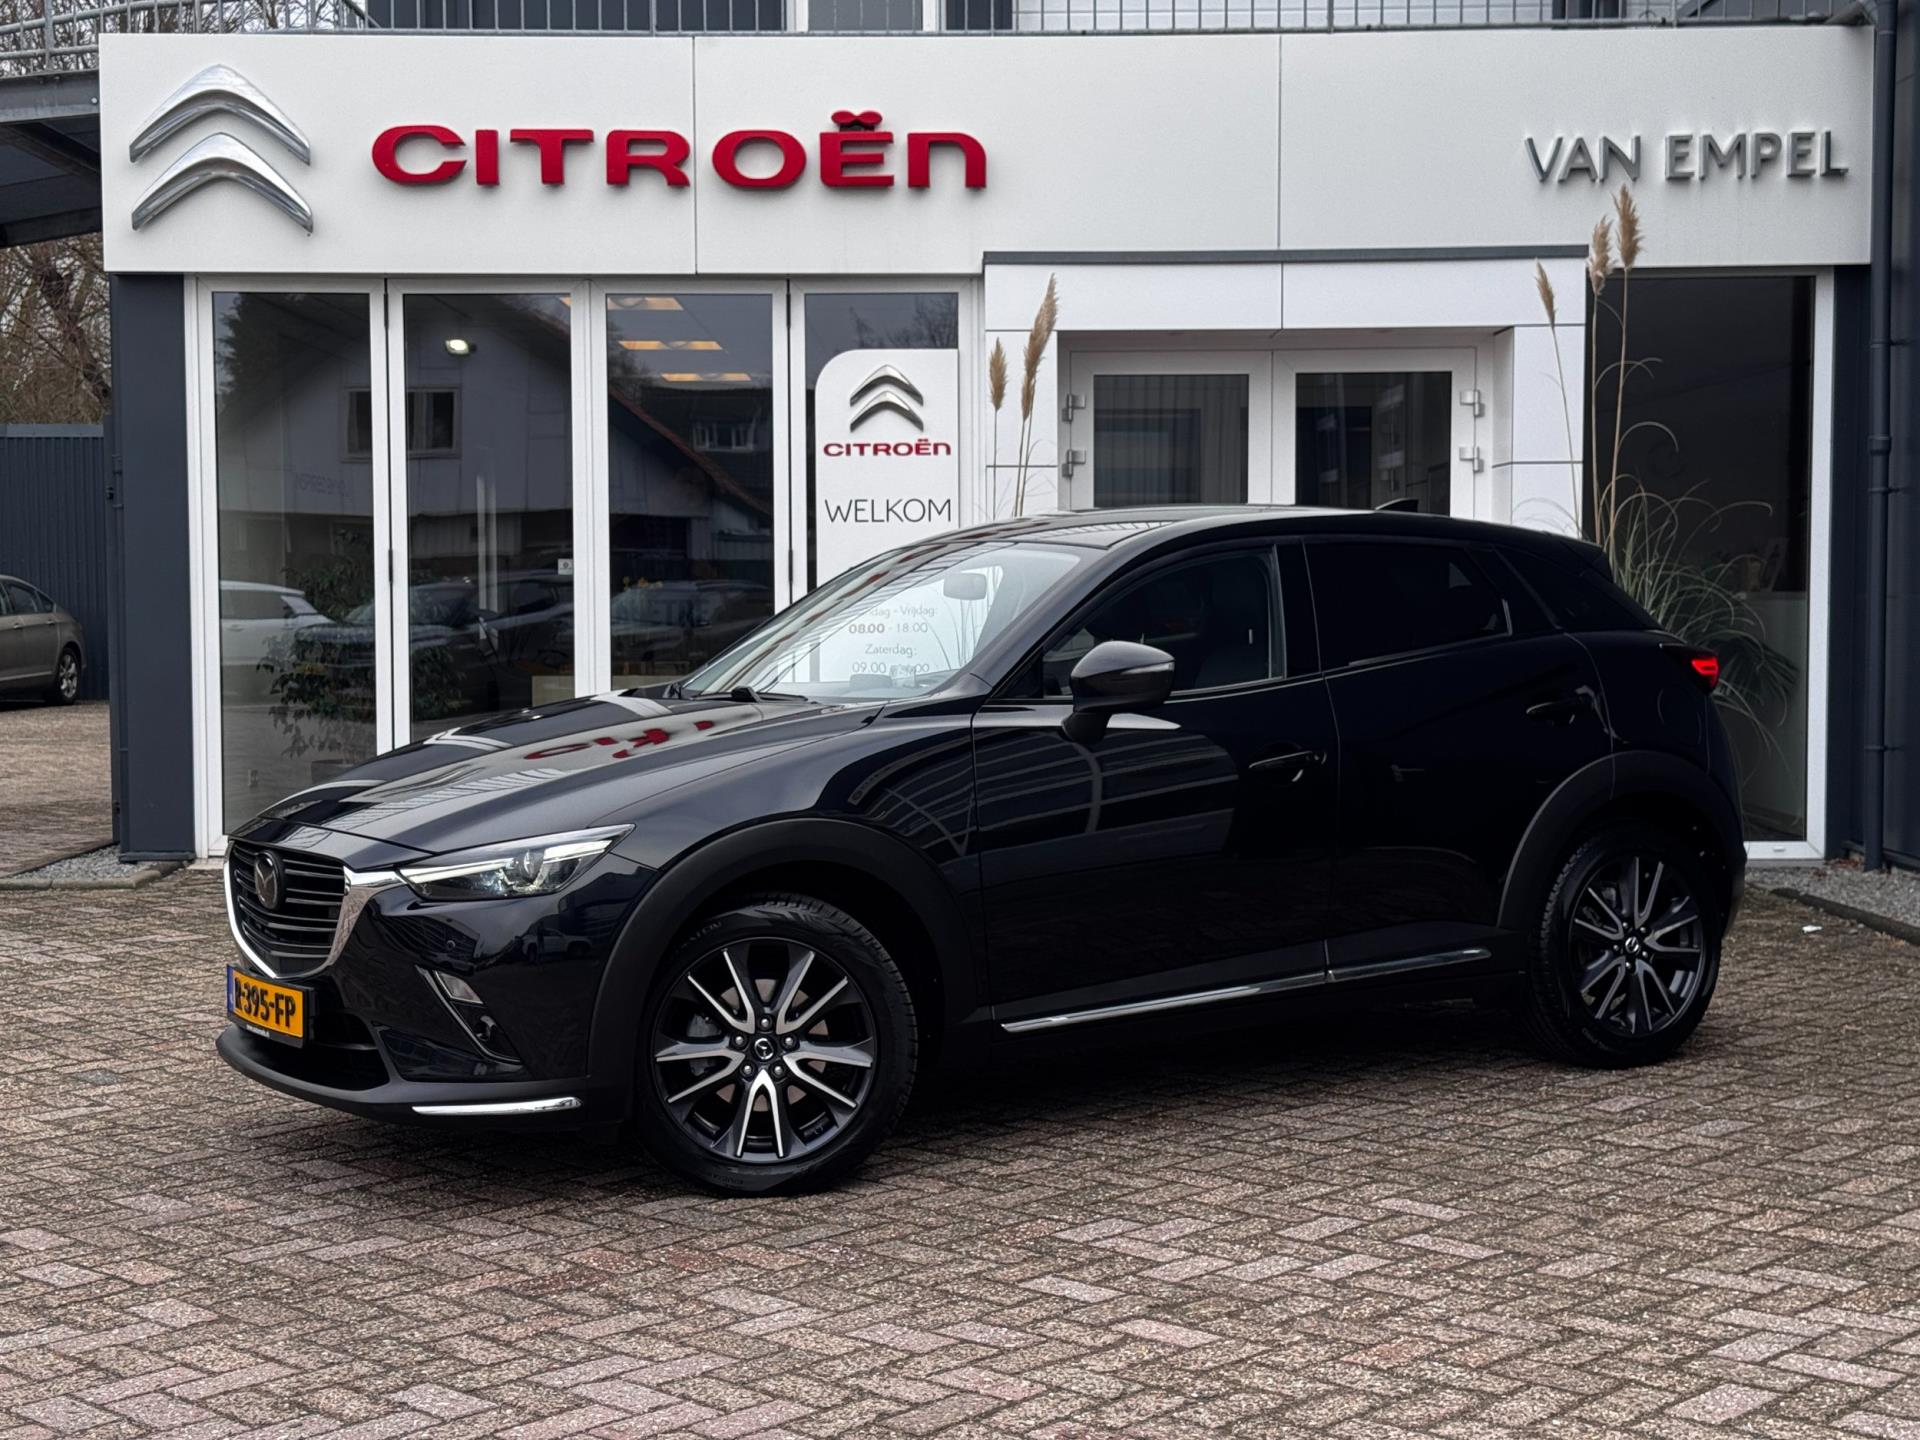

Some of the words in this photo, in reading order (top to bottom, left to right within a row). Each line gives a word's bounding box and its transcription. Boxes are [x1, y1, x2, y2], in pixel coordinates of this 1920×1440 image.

[1524, 136, 1642, 182] VAN
[1664, 131, 1850, 180] EMPEL
[825, 499, 951, 522] WELKOM
